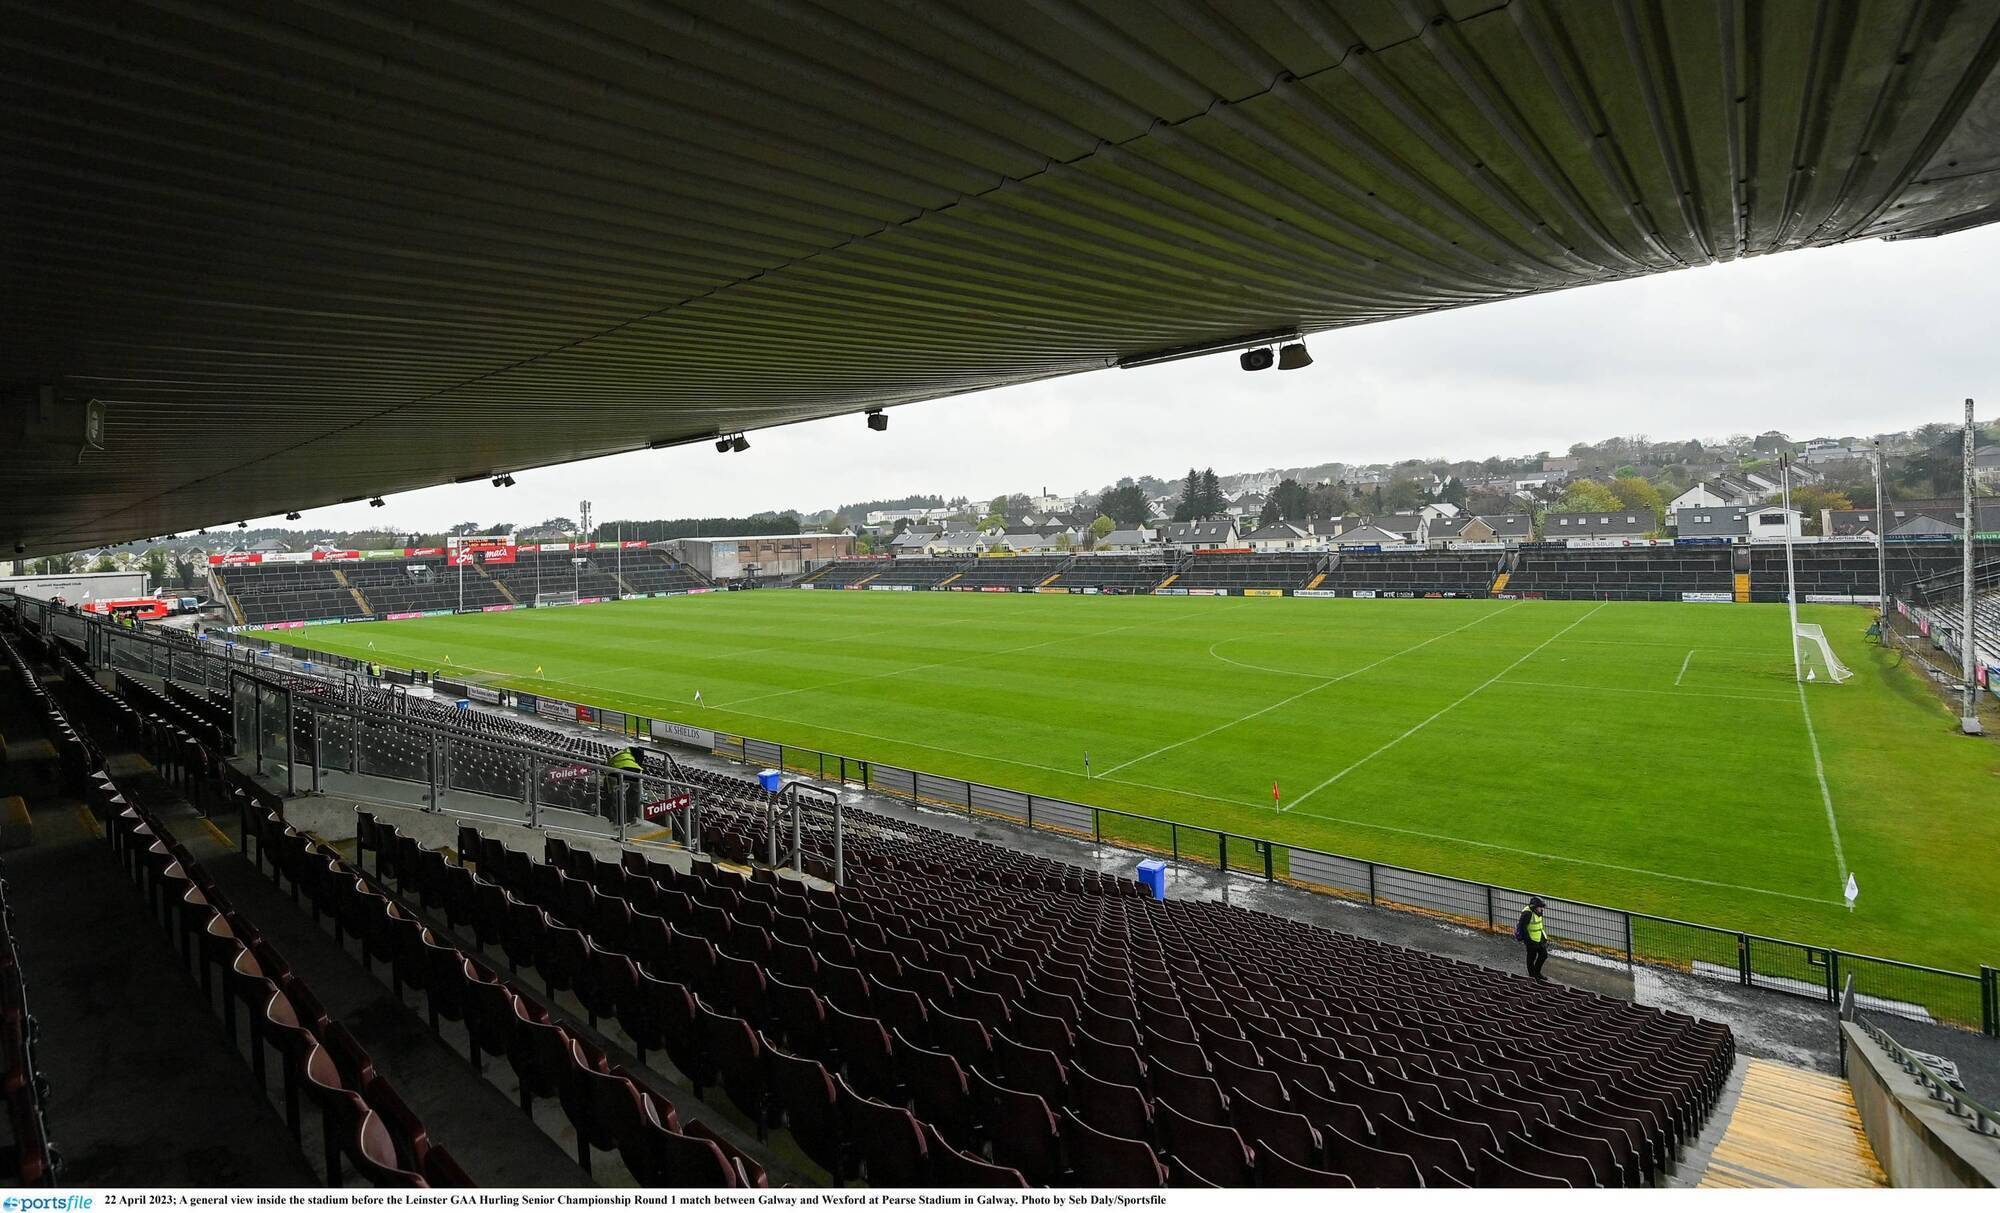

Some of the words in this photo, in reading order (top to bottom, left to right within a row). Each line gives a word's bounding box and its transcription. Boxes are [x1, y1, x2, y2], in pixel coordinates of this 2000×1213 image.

[664, 723, 674, 734] LK
[674, 725, 700, 740] SHIELDS
[550, 768, 577, 779] Toilet
[647, 800, 677, 816] Toilet
